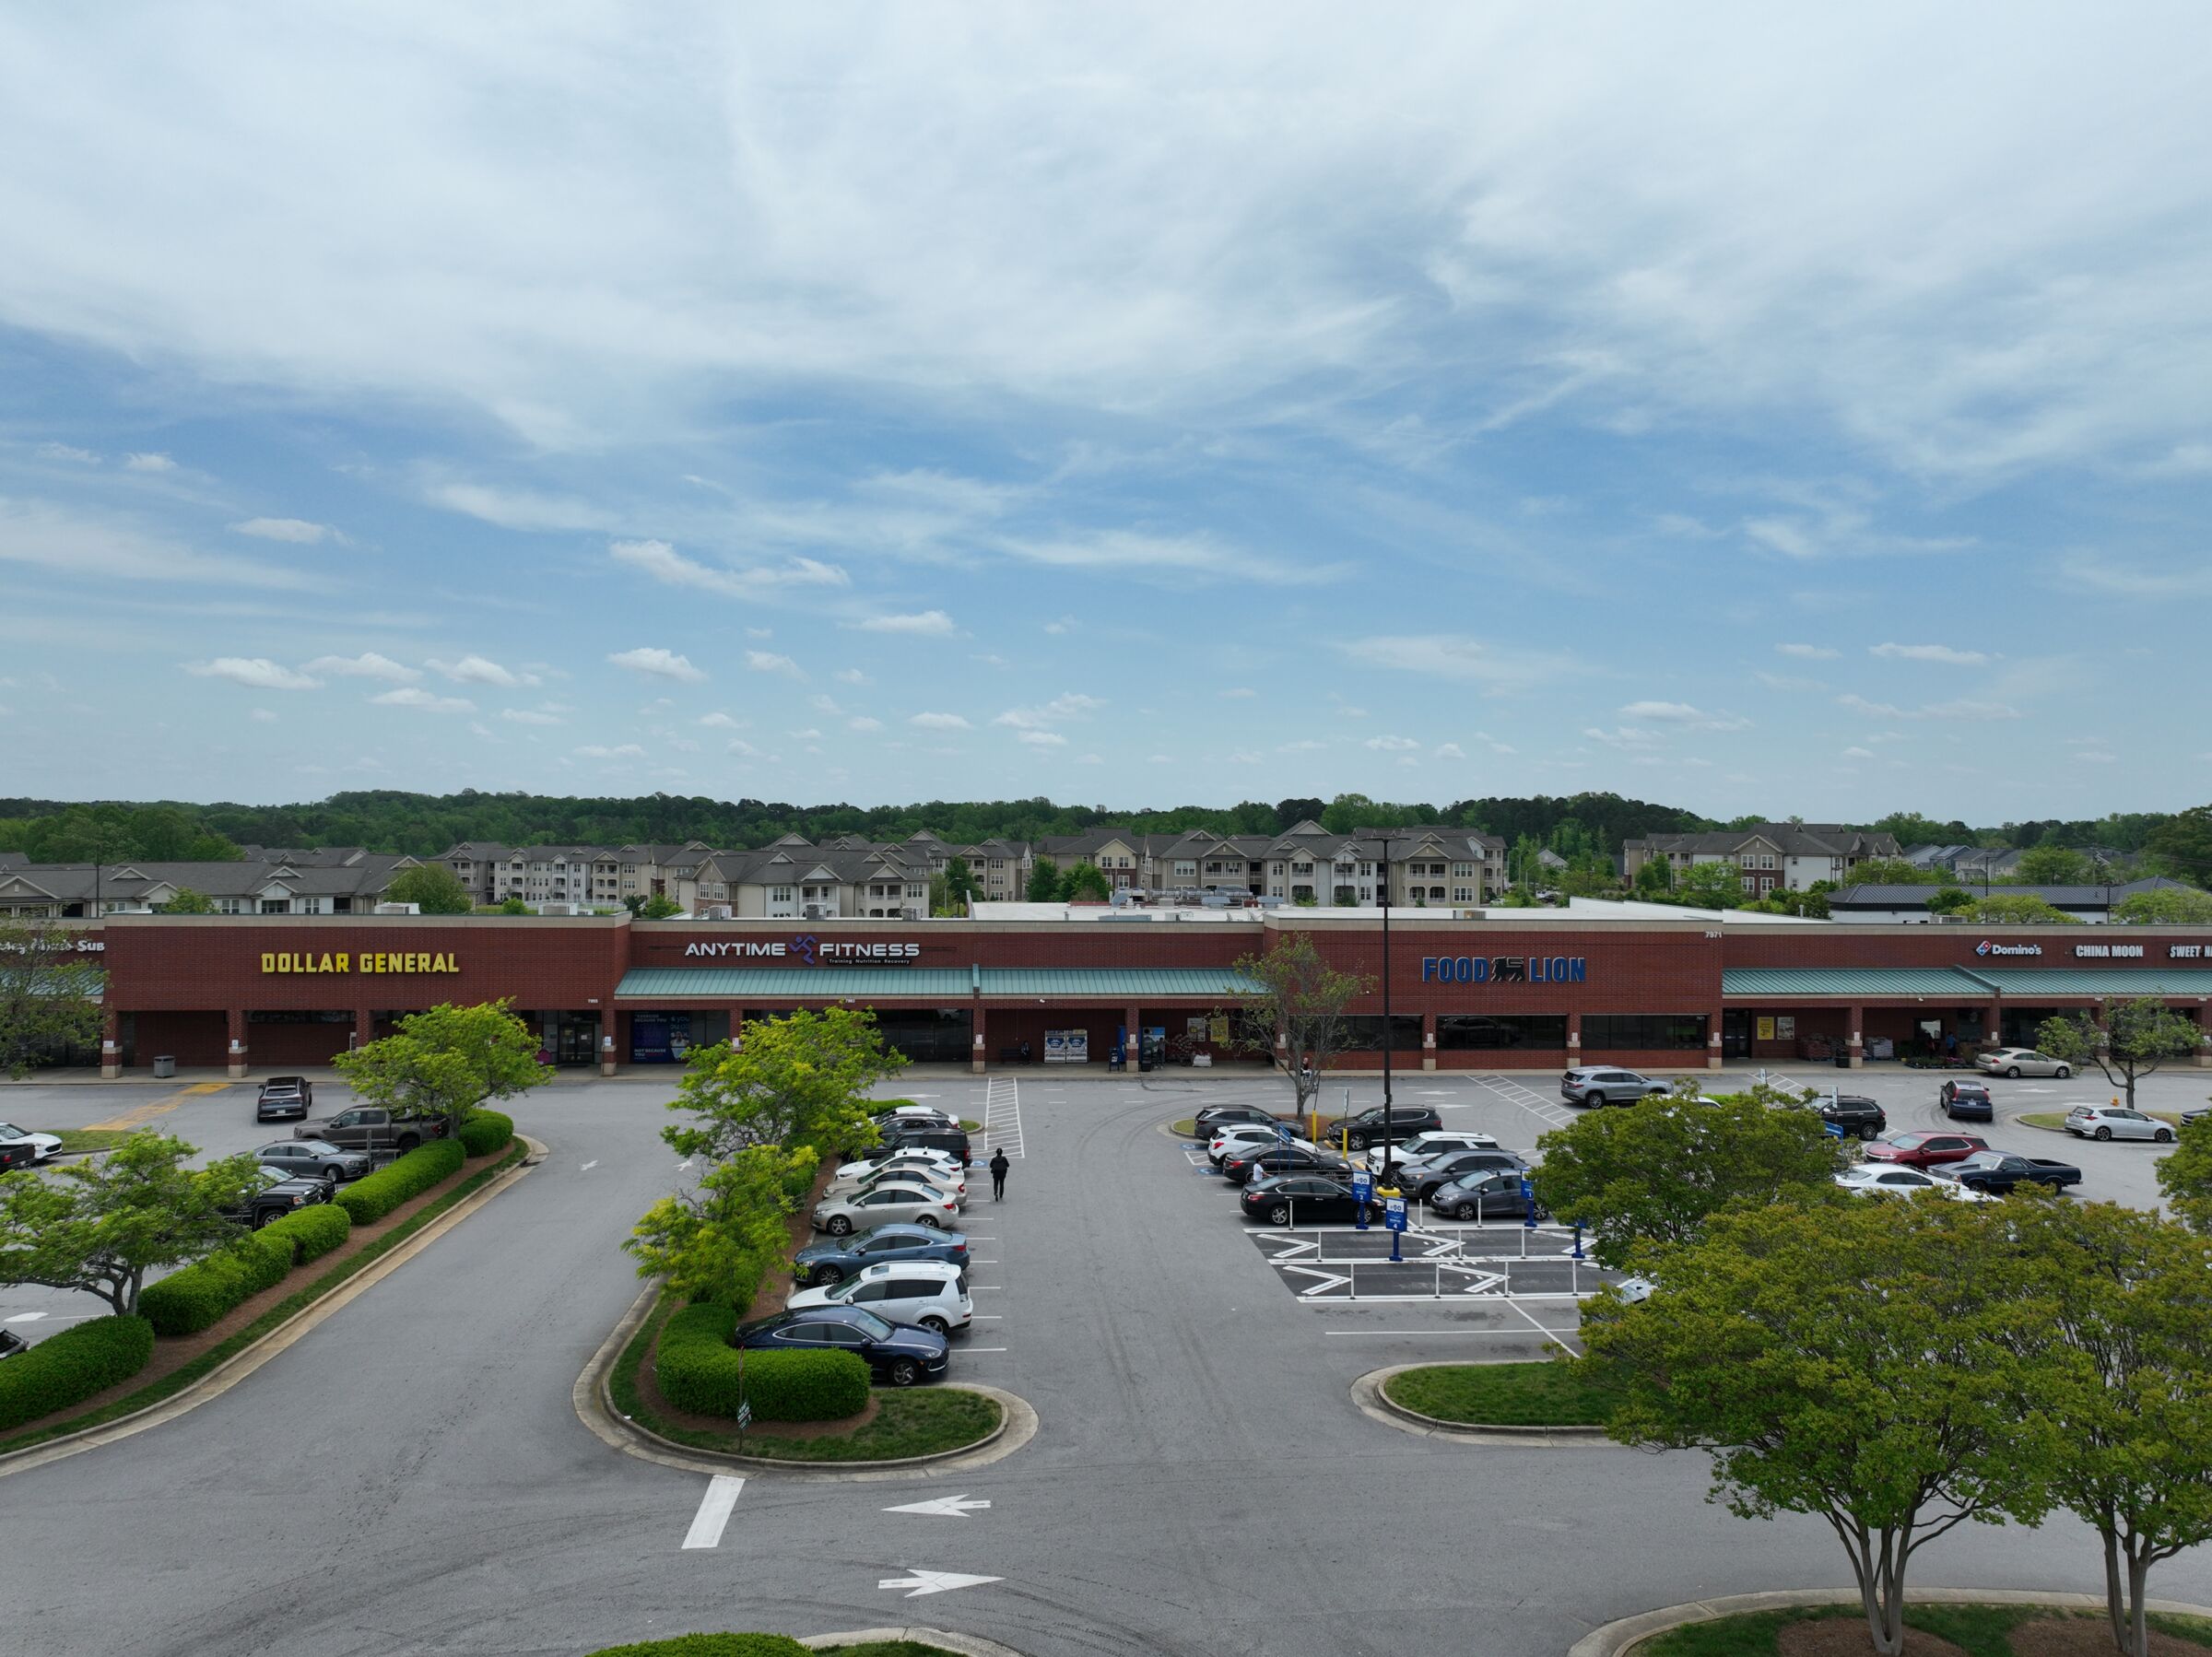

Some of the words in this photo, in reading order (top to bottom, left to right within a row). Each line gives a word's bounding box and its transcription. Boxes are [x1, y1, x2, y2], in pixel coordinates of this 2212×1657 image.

[685, 943, 785, 957] ANYTIME
[819, 943, 920, 957] FITNESS
[1992, 945, 2042, 956] Domino's
[2076, 946, 2110, 958] CHINA
[2112, 946, 2143, 958] MOON
[2170, 946, 2201, 958] SWEET
[262, 953, 349, 973] DOLLAR
[359, 953, 460, 973] GENERAL
[1422, 957, 1489, 983] FOOD
[1529, 957, 1585, 983] LION
